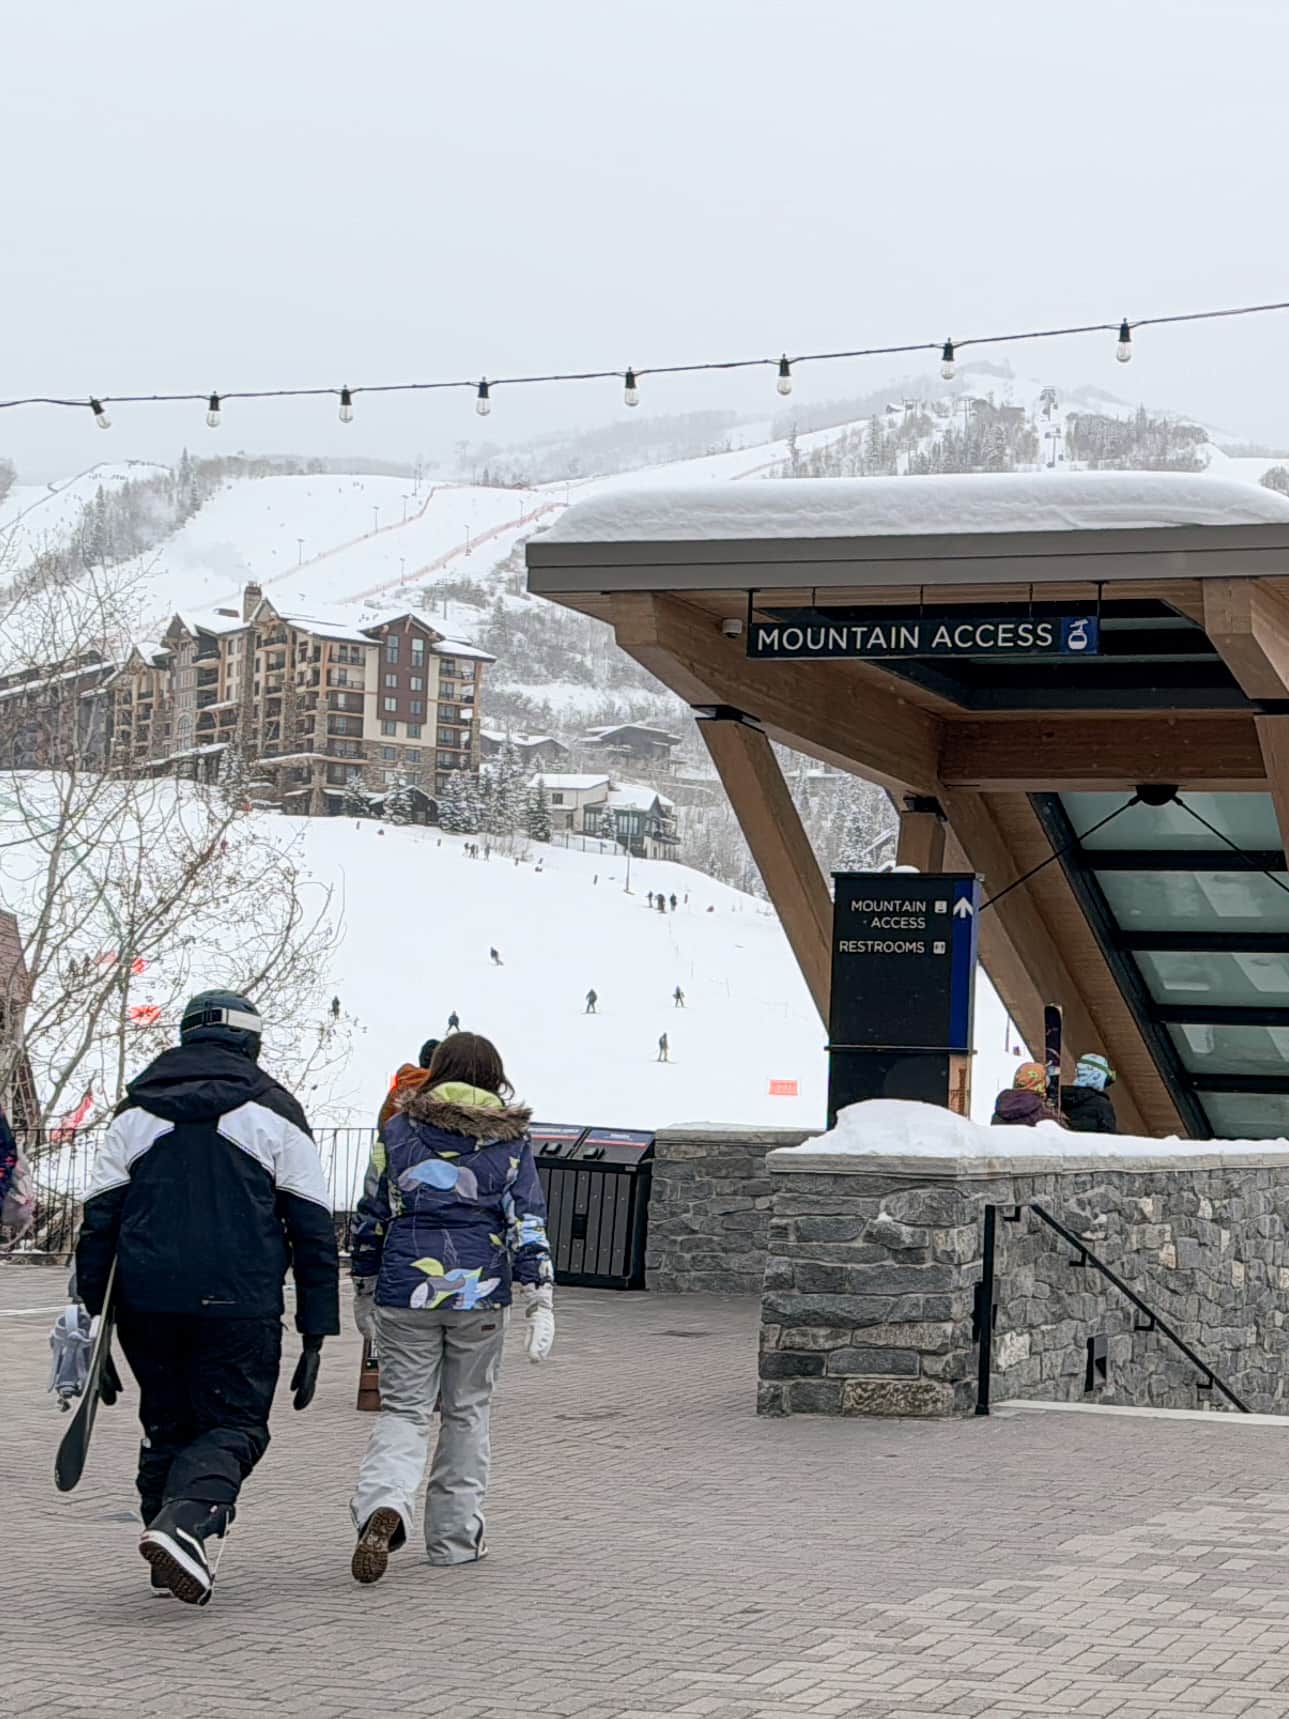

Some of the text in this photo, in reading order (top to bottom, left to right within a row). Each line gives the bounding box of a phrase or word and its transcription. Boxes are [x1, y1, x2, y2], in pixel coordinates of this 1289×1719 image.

[758, 623, 1052, 650] MOUNTAIN ACCESS
[851, 900, 926, 912] MOUNTAIN
[871, 917, 926, 929] ACCESS
[840, 941, 925, 953] RESTROOMS
